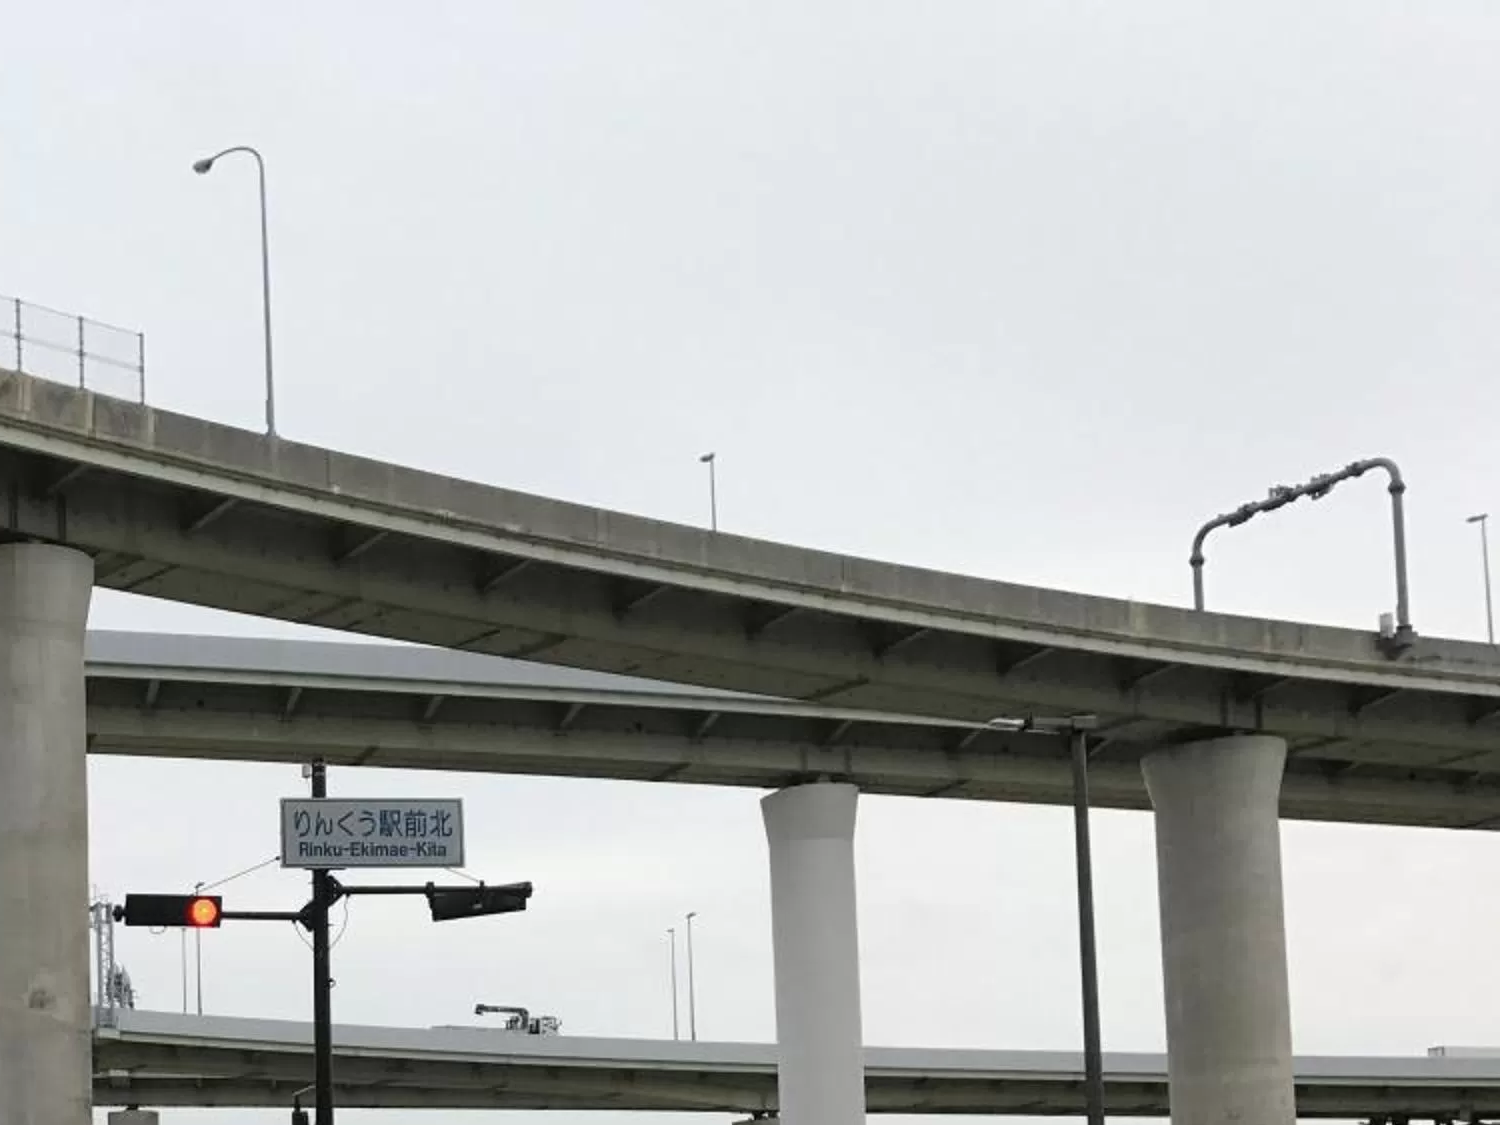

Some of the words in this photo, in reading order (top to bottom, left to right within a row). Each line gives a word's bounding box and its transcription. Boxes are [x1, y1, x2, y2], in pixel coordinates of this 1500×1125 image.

[294, 809, 453, 838] りんくう駅前北
[299, 841, 447, 857] Rinku-Ekimae-Kita
